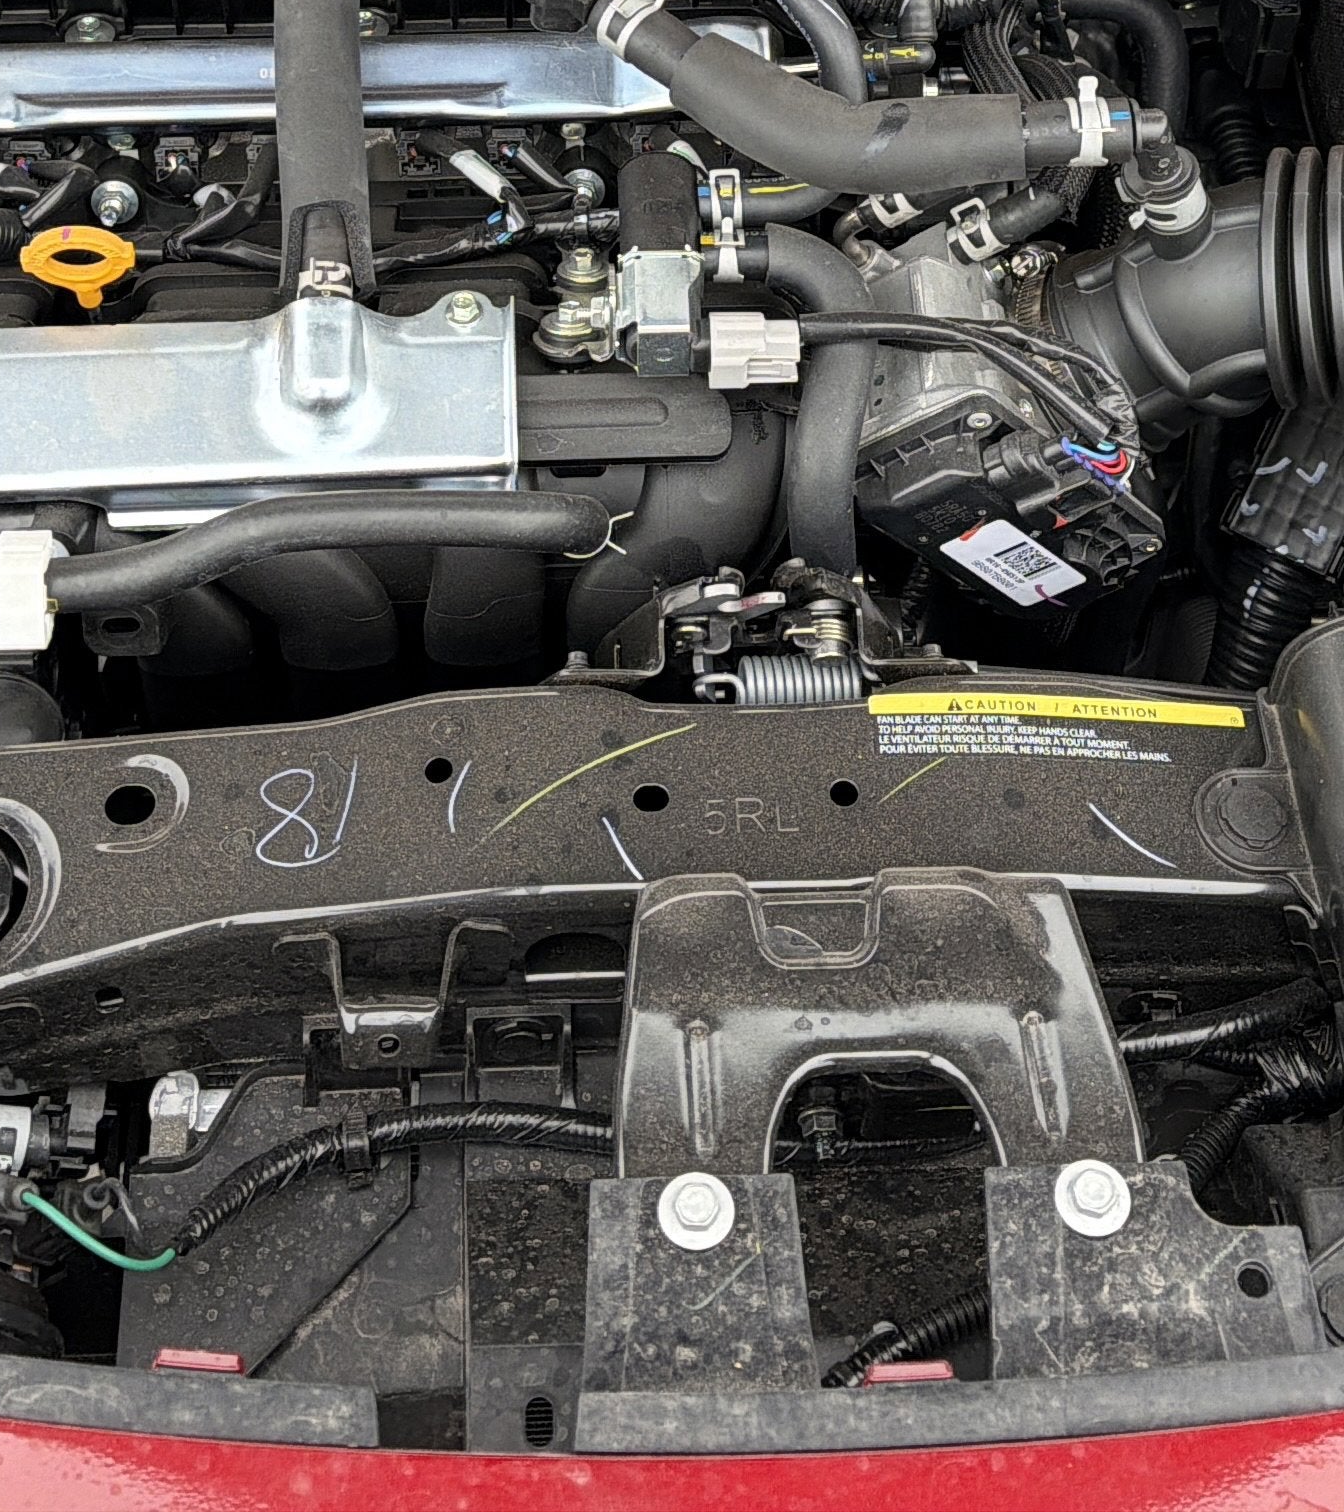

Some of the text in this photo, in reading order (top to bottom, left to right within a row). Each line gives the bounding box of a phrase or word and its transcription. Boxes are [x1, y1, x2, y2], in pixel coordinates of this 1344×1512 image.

[964, 699, 1036, 711] CAUTION
[1072, 703, 1158, 718] ATTENTION
[877, 715, 894, 724] FAN
[895, 715, 922, 724] BLADE
[923, 715, 942, 724] CAN
[943, 715, 968, 724] START
[969, 715, 980, 724] AT
[879, 725, 890, 734] TO
[892, 725, 913, 734] HELP
[914, 725, 941, 734] AVOID
[942, 725, 986, 735] PERSONAL
[1018, 726, 1038, 735] KEEP
[1039, 726, 1068, 737] HANDS
[1069, 728, 1098, 738] CLEAR.
[878, 735, 890, 744] LE
[891, 735, 951, 744] VENTILATEUR
[953, 735, 986, 744] RISQUE
[987, 735, 1001, 744] DE
[1002, 734, 1052, 745] DÉMARRER
[1062, 738, 1085, 748] TOUT
[1087, 739, 1131, 750] MOMENT.
[879, 743, 1172, 762] POUR ÉVITER TOUTE BLESSURE, NE PAS EN APPROCHER LES MAINS.
